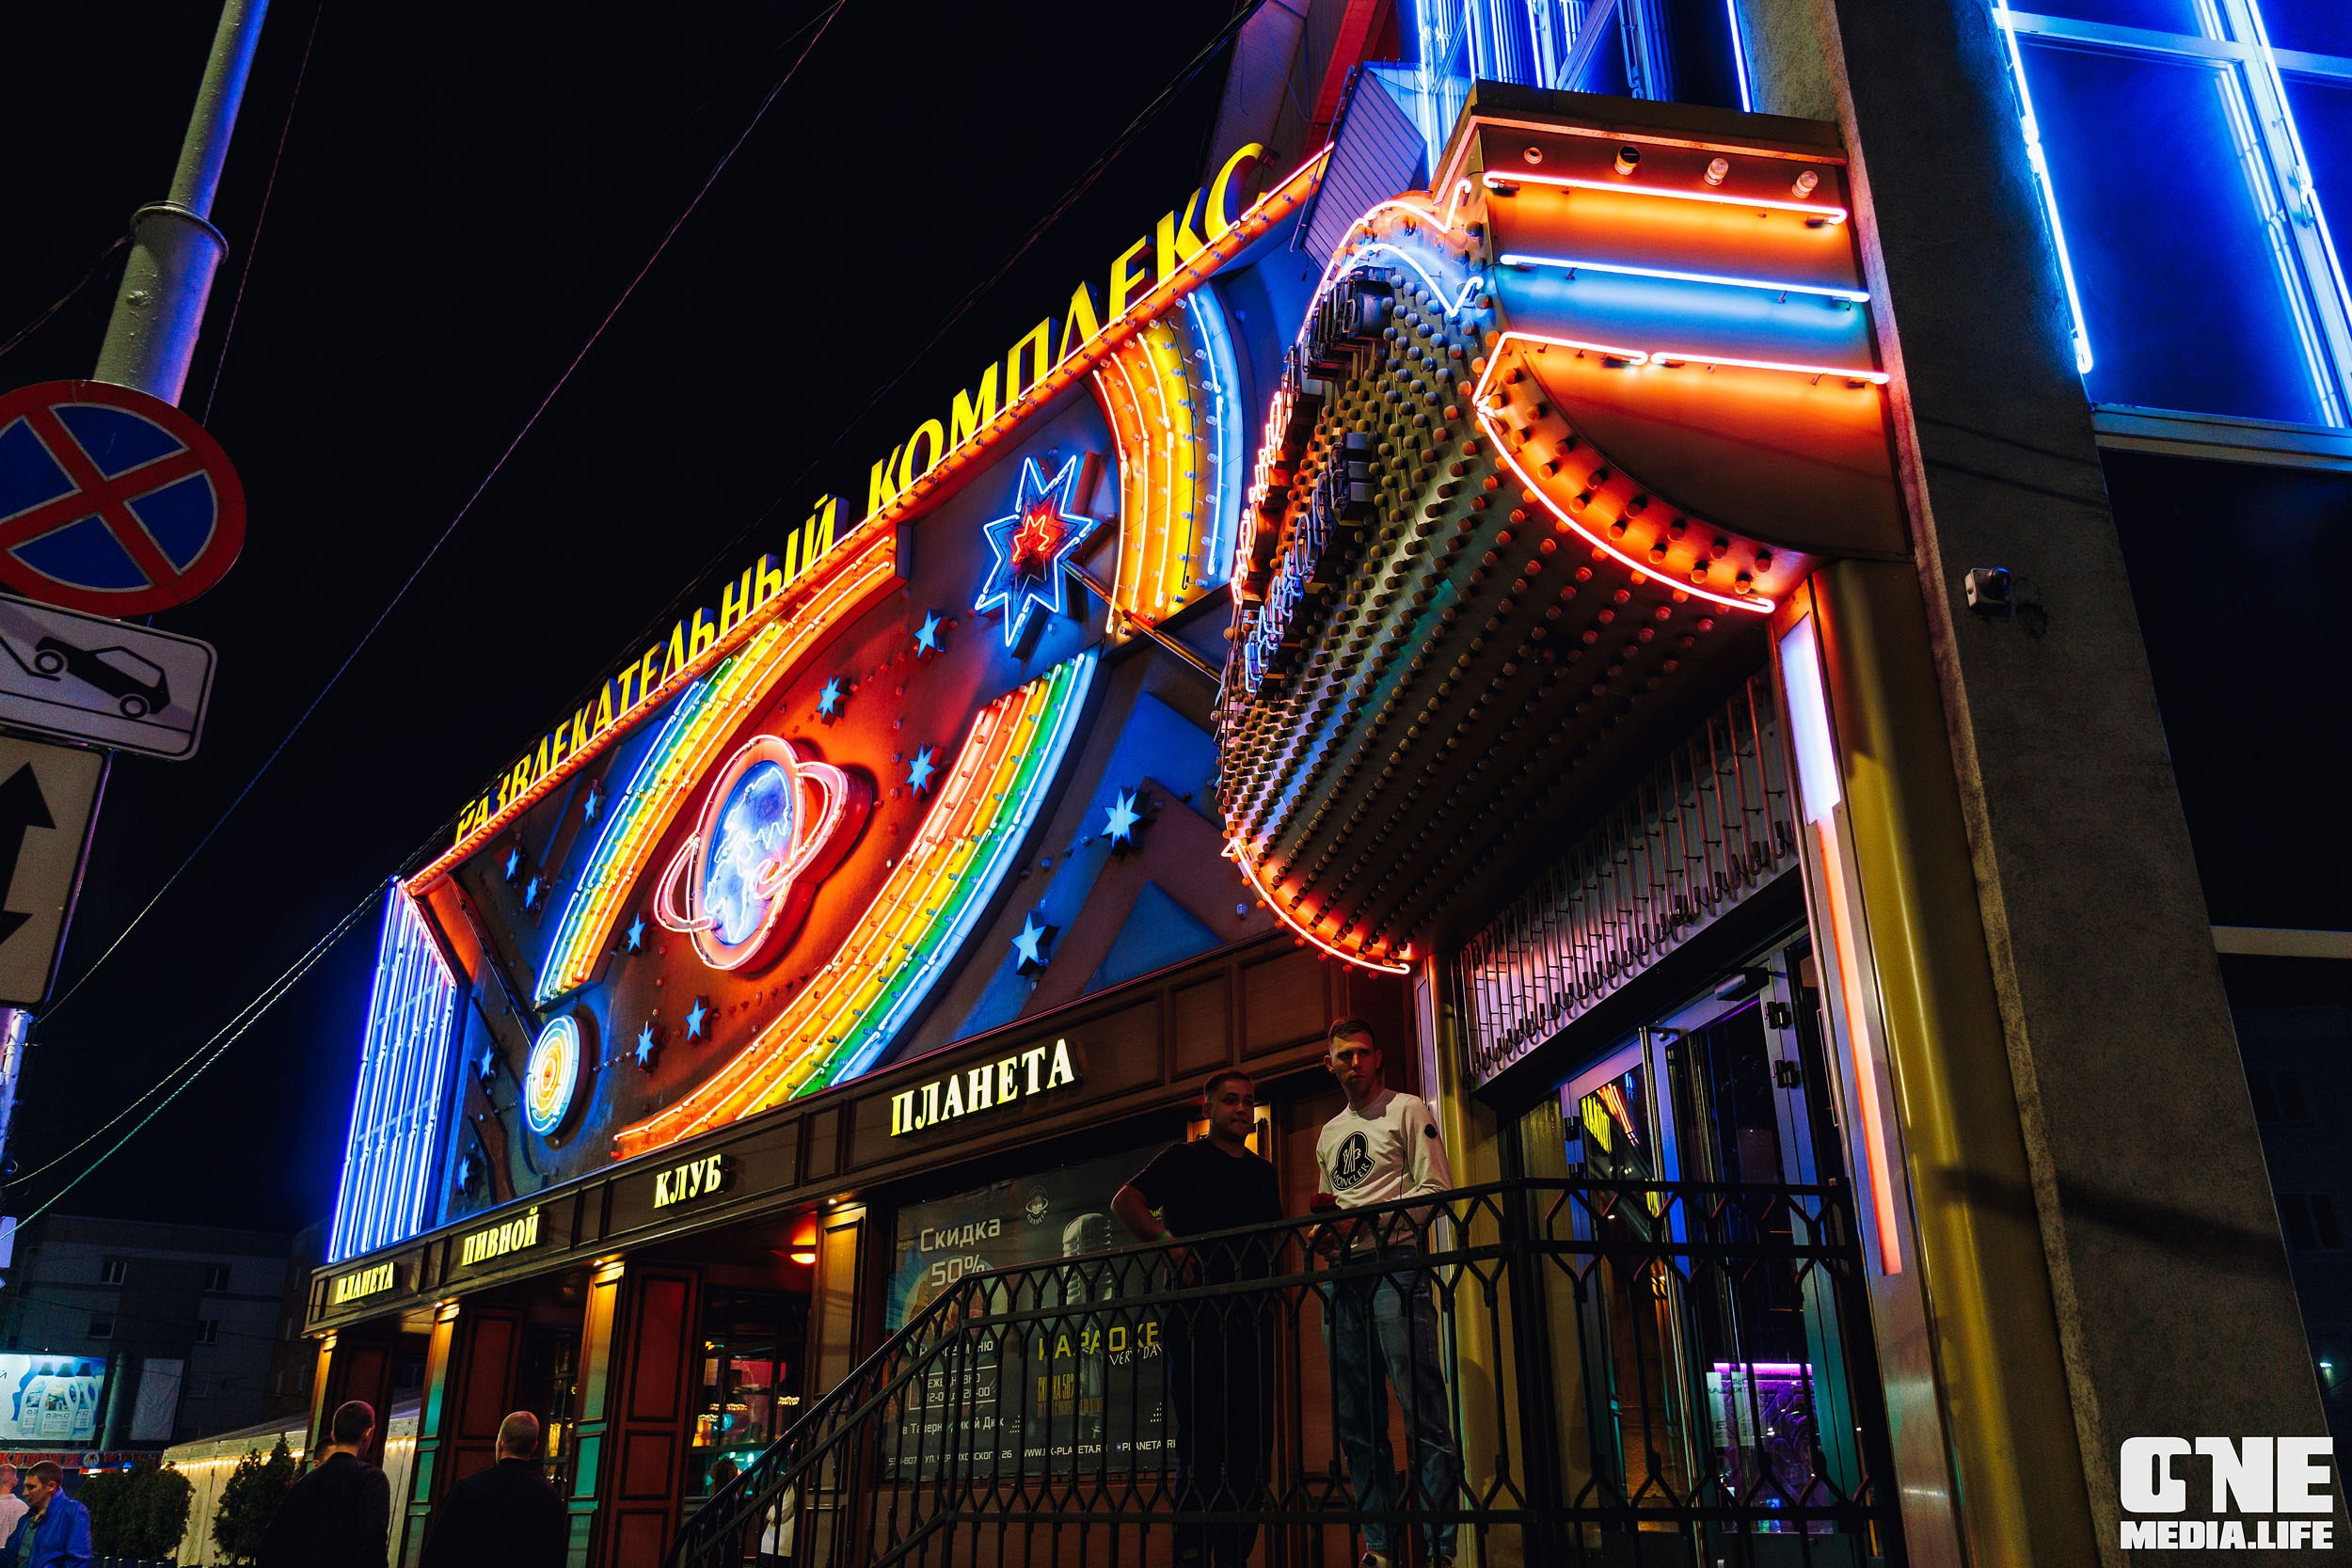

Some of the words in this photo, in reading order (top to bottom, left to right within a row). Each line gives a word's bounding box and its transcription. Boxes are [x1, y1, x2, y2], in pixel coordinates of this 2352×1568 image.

[866, 143, 1267, 516] КОМПЛЕКС
[334, 1262, 395, 1304] ПЛАНЕТА
[461, 1207, 541, 1266] ПИВНОЙ
[654, 1153, 723, 1209] КЛУБ
[889, 1037, 1076, 1137] ПЛАНЕТА
[1331, 1163, 1371, 1187] MONCLER
[920, 1218, 1001, 1253] Скидка
[930, 1254, 985, 1288] 50%
[1001, 1449, 1012, 1459] 26
